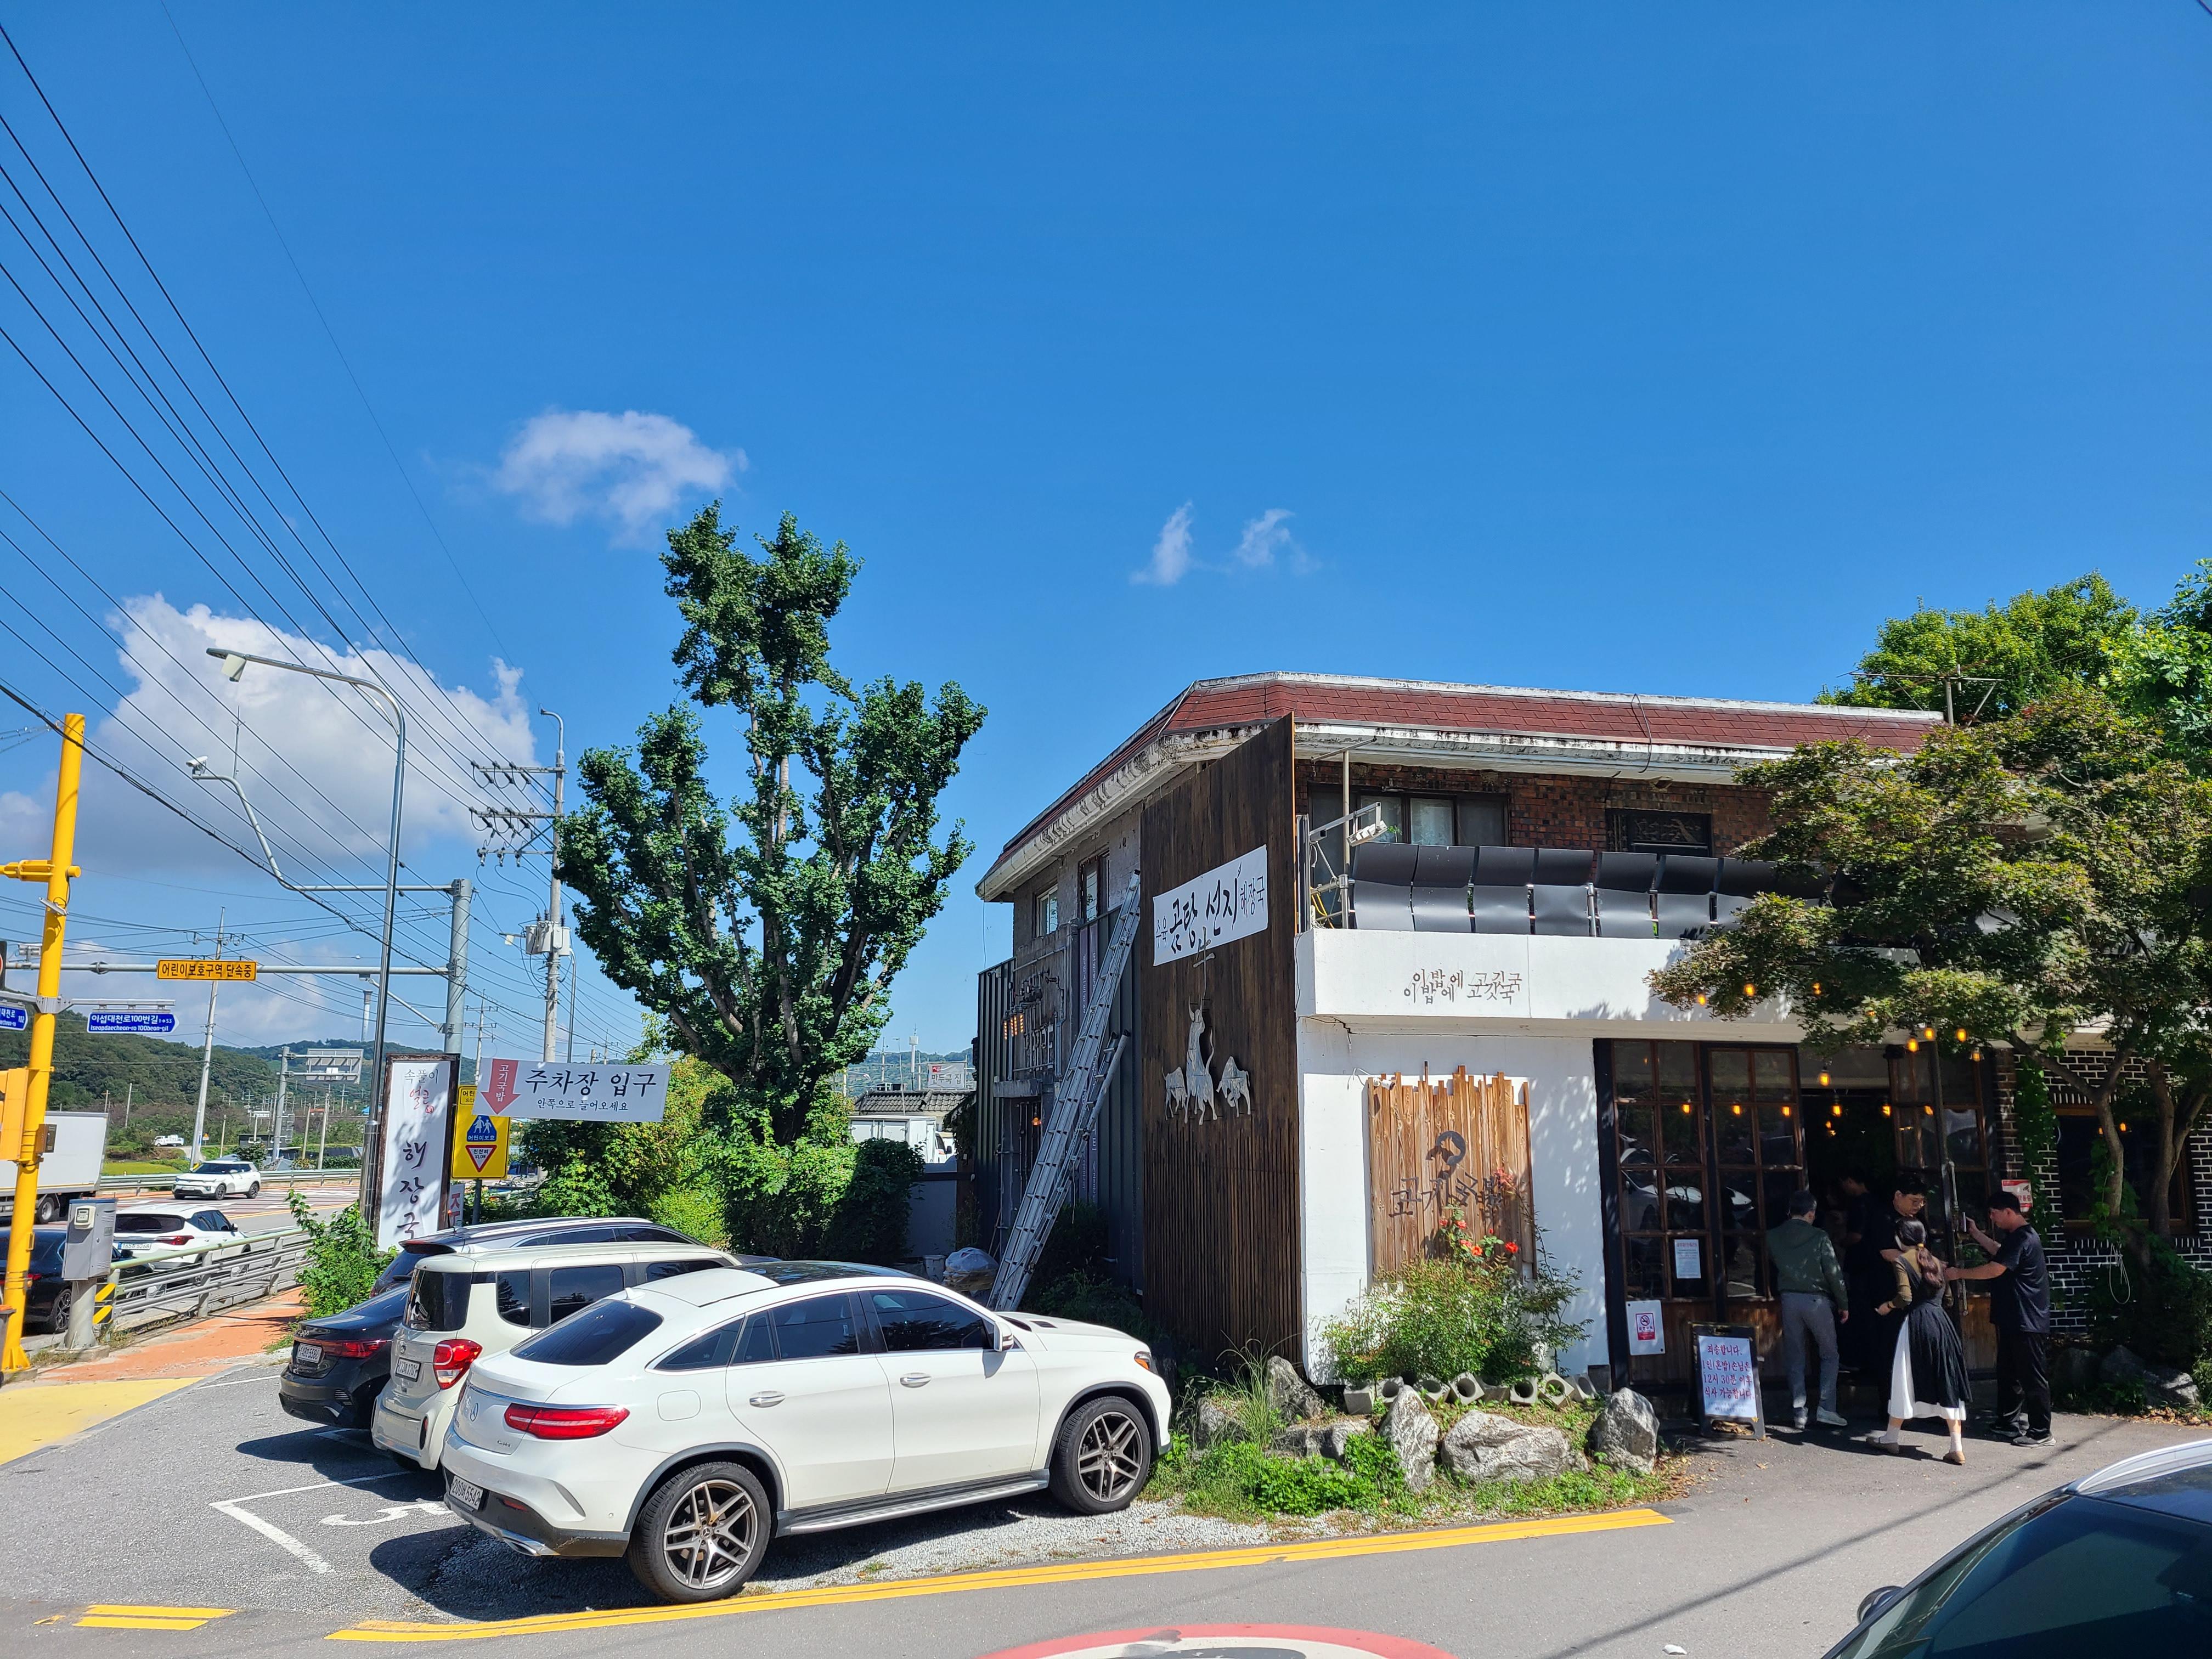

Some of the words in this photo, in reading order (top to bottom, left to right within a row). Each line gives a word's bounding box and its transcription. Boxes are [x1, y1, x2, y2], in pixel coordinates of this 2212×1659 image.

[1155, 916, 1168, 950] 수육
[1169, 891, 1198, 954] 곰탕
[1239, 876, 1265, 918] 해장국
[162, 963, 223, 978] 어린이보호구역
[227, 964, 251, 978] 단속중
[91, 1015, 159, 1024] 이섭대천로100번길
[404, 1068, 438, 1085] 속풀이
[495, 1064, 510, 1103] 고기국밥
[524, 1069, 600, 1097] 주차장
[610, 1071, 658, 1098] 입구
[537, 1098, 575, 1110] 안쪽으로
[579, 1099, 628, 1112] 들어오세요
[397, 1141, 427, 1239] 해장국
[1707, 1344, 1743, 1356] 죄송합니다.
[1703, 1373, 1719, 1384] 12시
[1721, 1374, 1737, 1385] 30분
[1739, 1374, 1752, 1386] 이후
[1705, 1386, 1718, 1398] 식사
